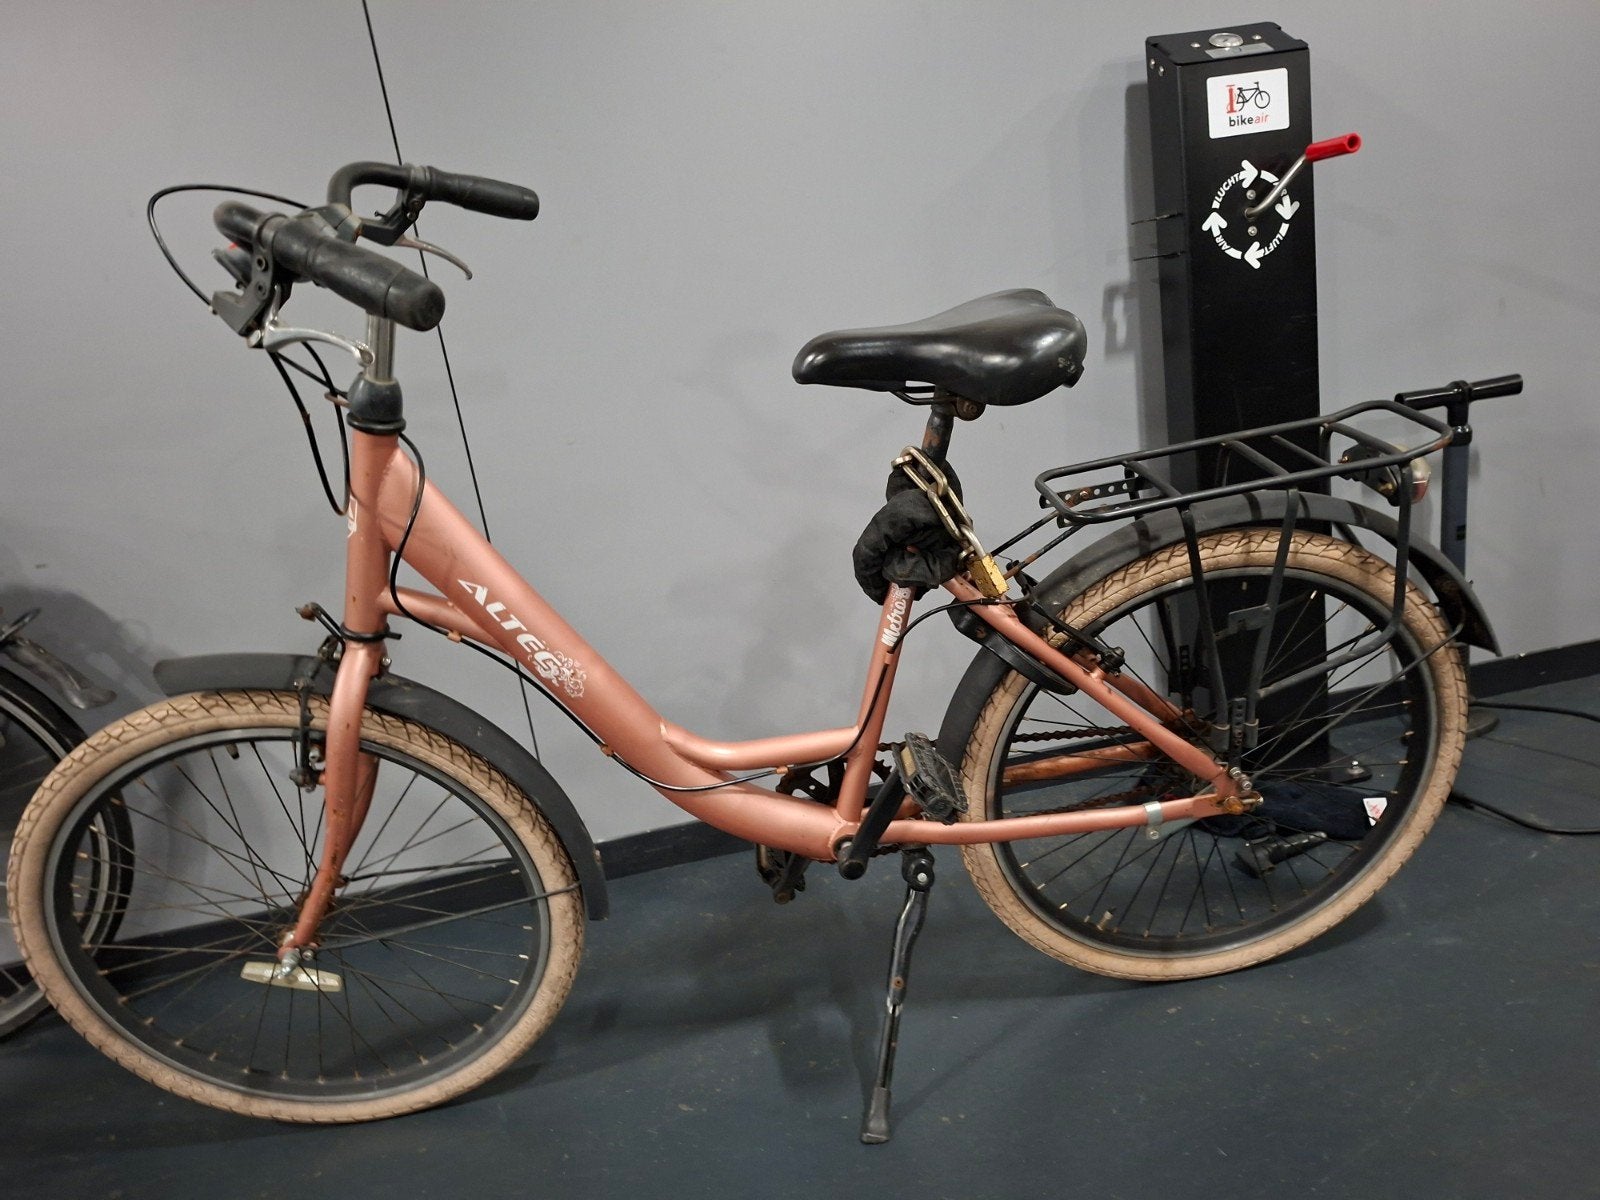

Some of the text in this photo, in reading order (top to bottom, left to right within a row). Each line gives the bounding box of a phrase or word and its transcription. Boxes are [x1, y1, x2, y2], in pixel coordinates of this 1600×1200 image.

[1228, 113, 1269, 127] bikeair
[1214, 172, 1241, 203] LUCHT
[1215, 235, 1230, 251] AIR
[1263, 233, 1284, 256] LUFT
[880, 599, 907, 647] Metro
